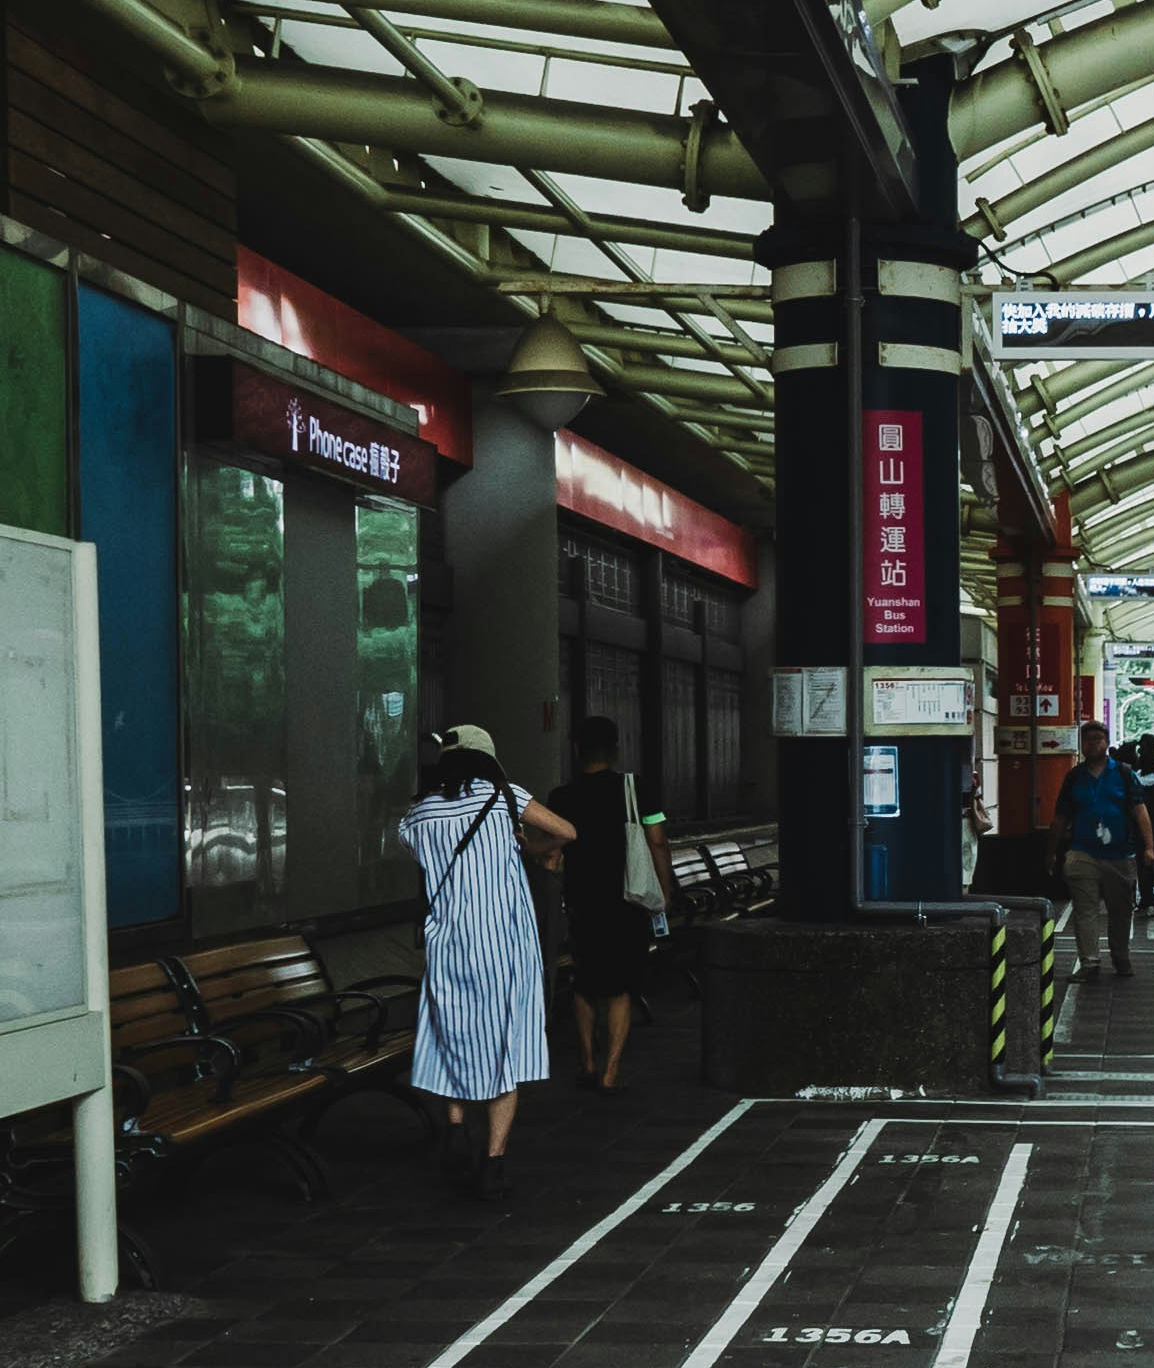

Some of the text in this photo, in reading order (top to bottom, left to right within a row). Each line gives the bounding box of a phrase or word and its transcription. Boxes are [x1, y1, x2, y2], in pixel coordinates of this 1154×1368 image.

[309, 415, 342, 463] Phone
[343, 441, 367, 473] case
[878, 424, 907, 586] 圓山轉運站
[866, 596, 921, 607] Yuanshan
[884, 609, 906, 620] Bus
[875, 623, 915, 634] Station
[878, 1154, 981, 1164] 1356A
[660, 1201, 757, 1213] 1356
[762, 1327, 911, 1345] 1356A
